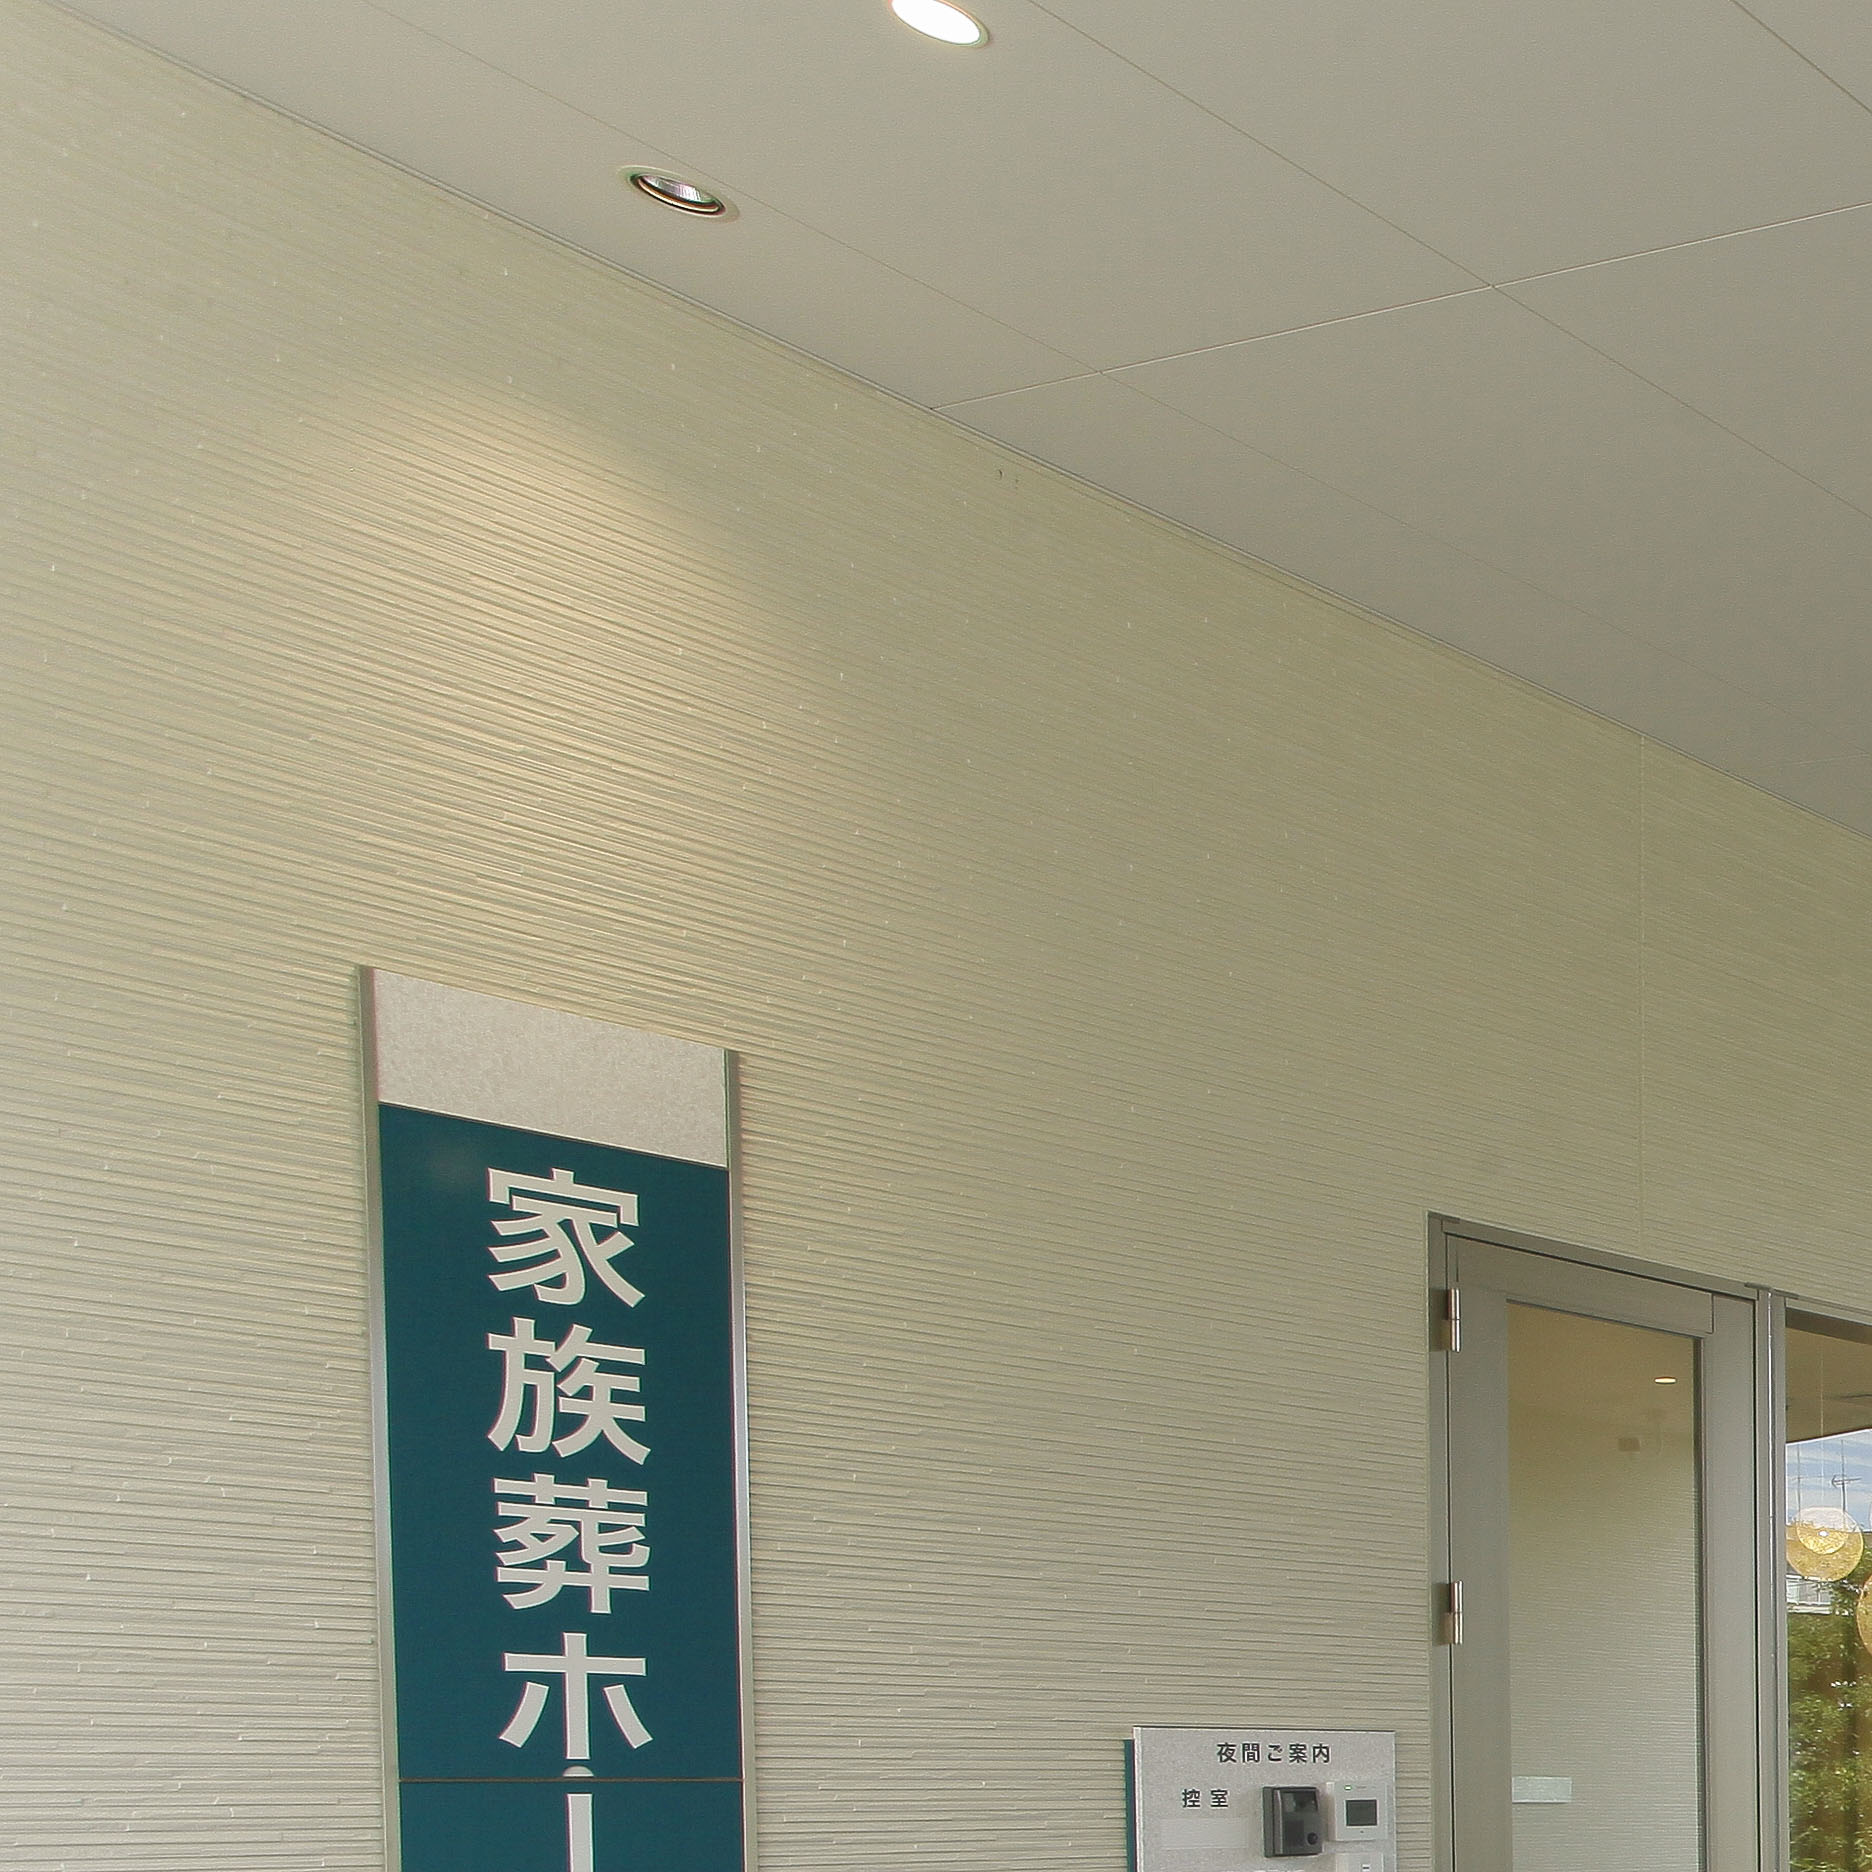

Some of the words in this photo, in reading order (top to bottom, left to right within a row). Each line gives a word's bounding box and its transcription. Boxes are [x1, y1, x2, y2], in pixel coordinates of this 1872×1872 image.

[1217, 1743, 1331, 1763] 夜間ご案内
[1182, 1789, 1229, 1808] 控室
